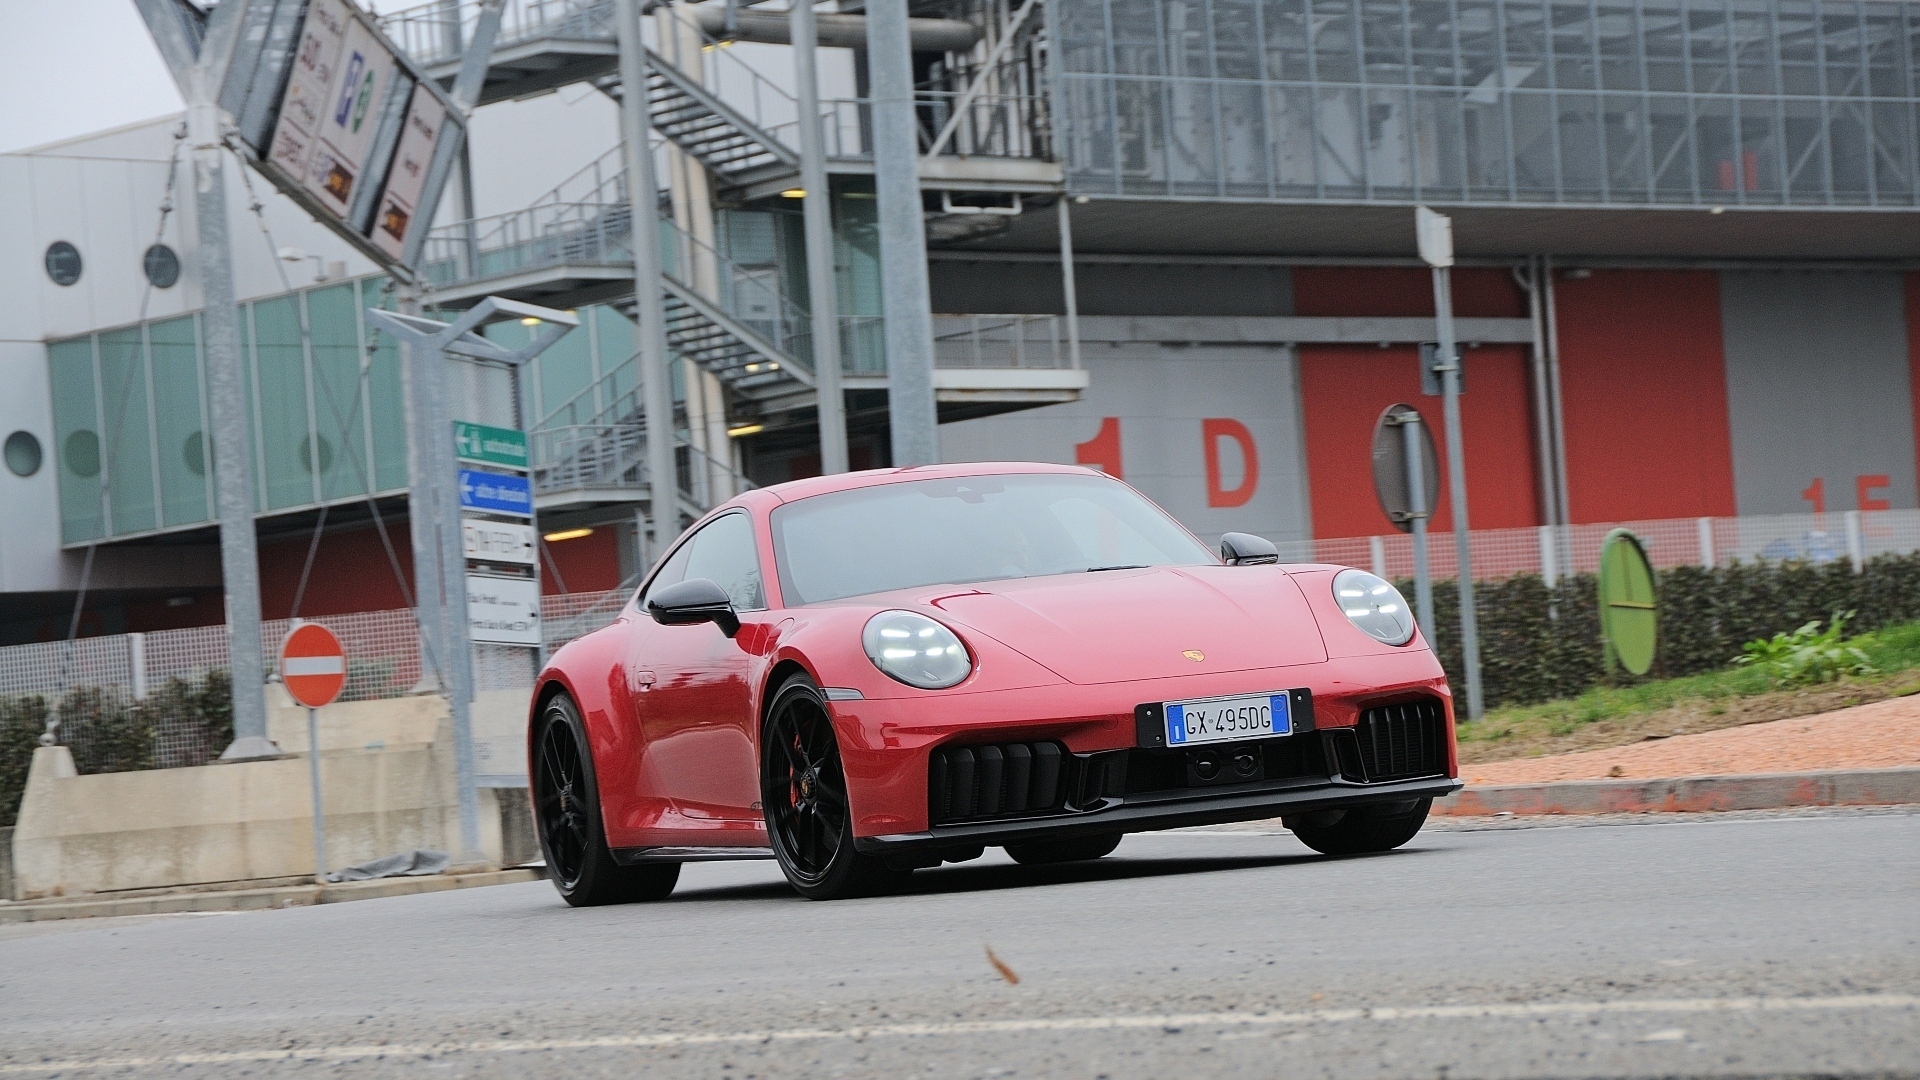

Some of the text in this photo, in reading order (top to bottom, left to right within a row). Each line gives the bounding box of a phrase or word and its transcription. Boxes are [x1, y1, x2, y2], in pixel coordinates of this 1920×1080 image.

[1074, 416, 1260, 508] 1 D
[1802, 474, 1893, 537] 1 E
[1185, 706, 1271, 735] GX 495DG
